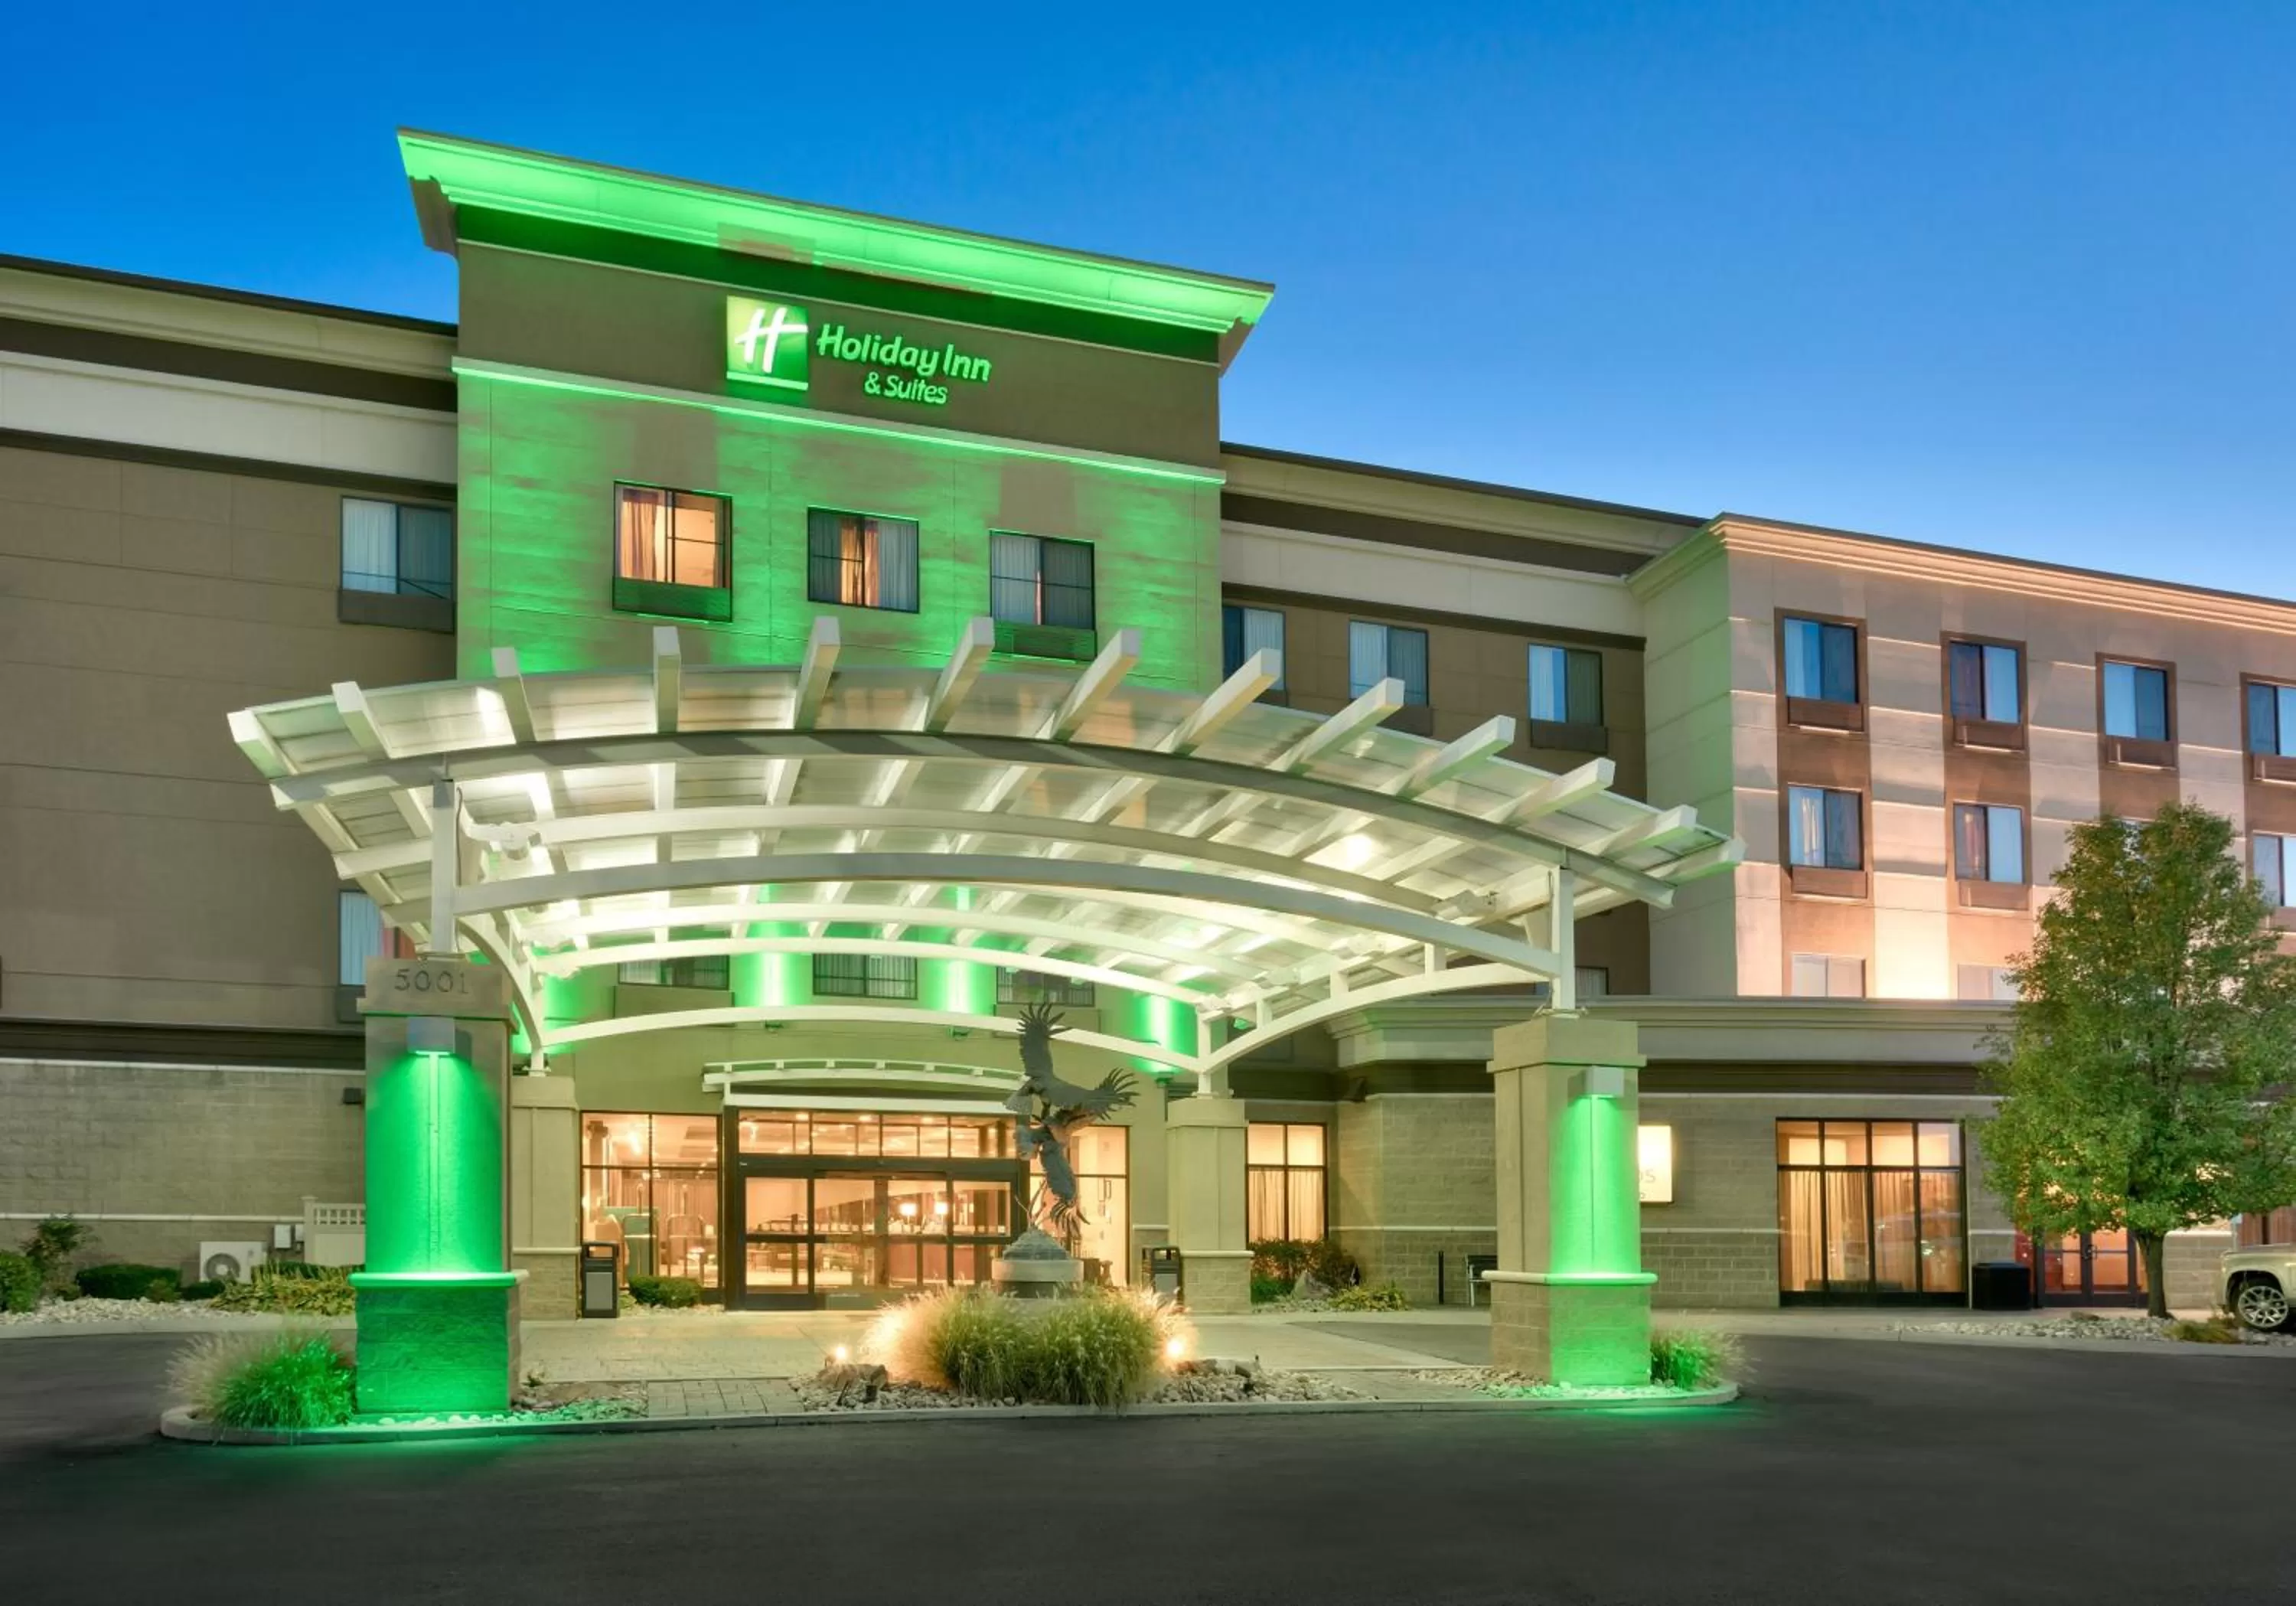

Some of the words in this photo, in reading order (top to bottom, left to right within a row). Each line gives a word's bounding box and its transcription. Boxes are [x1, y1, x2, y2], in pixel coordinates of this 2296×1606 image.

[817, 323, 941, 375] Holiday
[943, 343, 992, 382] Inn
[864, 372, 881, 395] &
[884, 375, 948, 405] Suites
[394, 968, 469, 994] 5001
